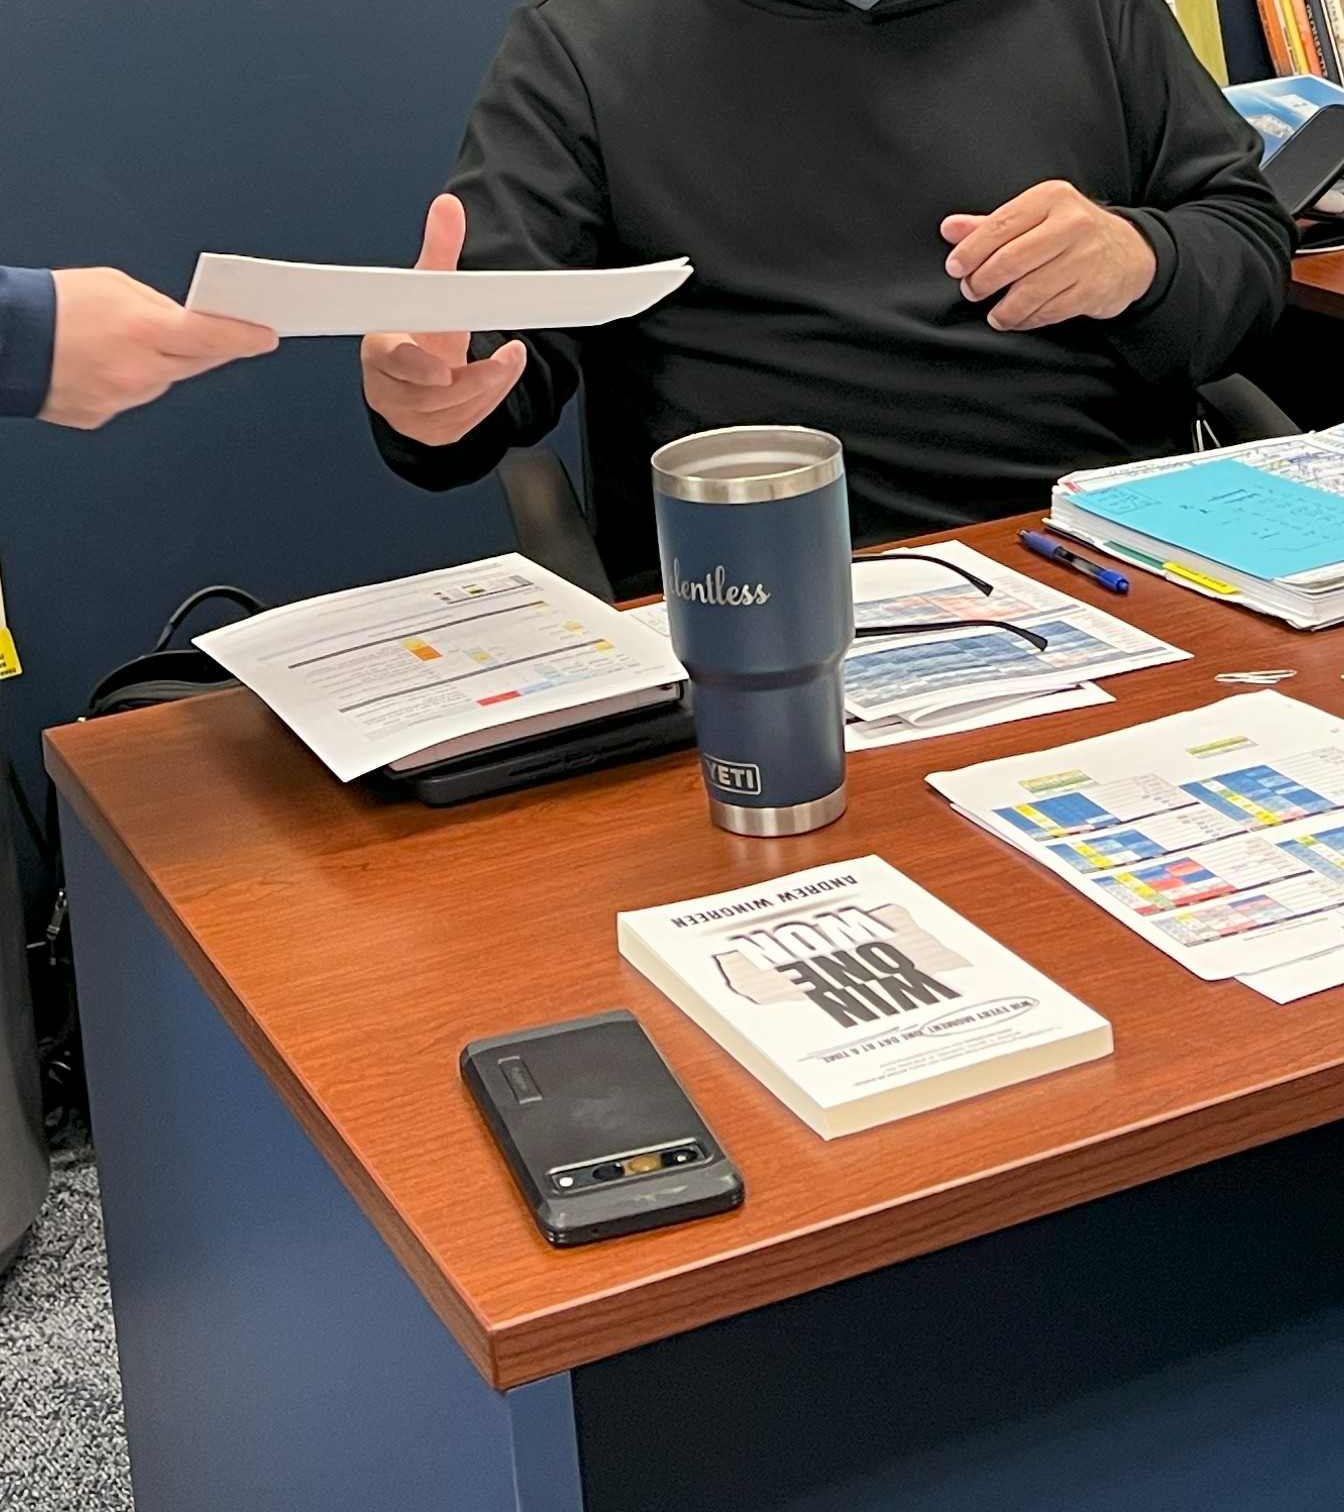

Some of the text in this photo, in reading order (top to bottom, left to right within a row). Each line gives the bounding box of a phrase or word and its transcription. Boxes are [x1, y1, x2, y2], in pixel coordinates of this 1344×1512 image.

[704, 758, 754, 789] YETI
[671, 875, 858, 928] ANDREW WINGREEN
[729, 906, 898, 971] WON
[775, 942, 915, 997] ONE
[803, 969, 963, 1028] WIN
[977, 1006, 1010, 1020] EVERY
[877, 1037, 900, 1049] DAY
